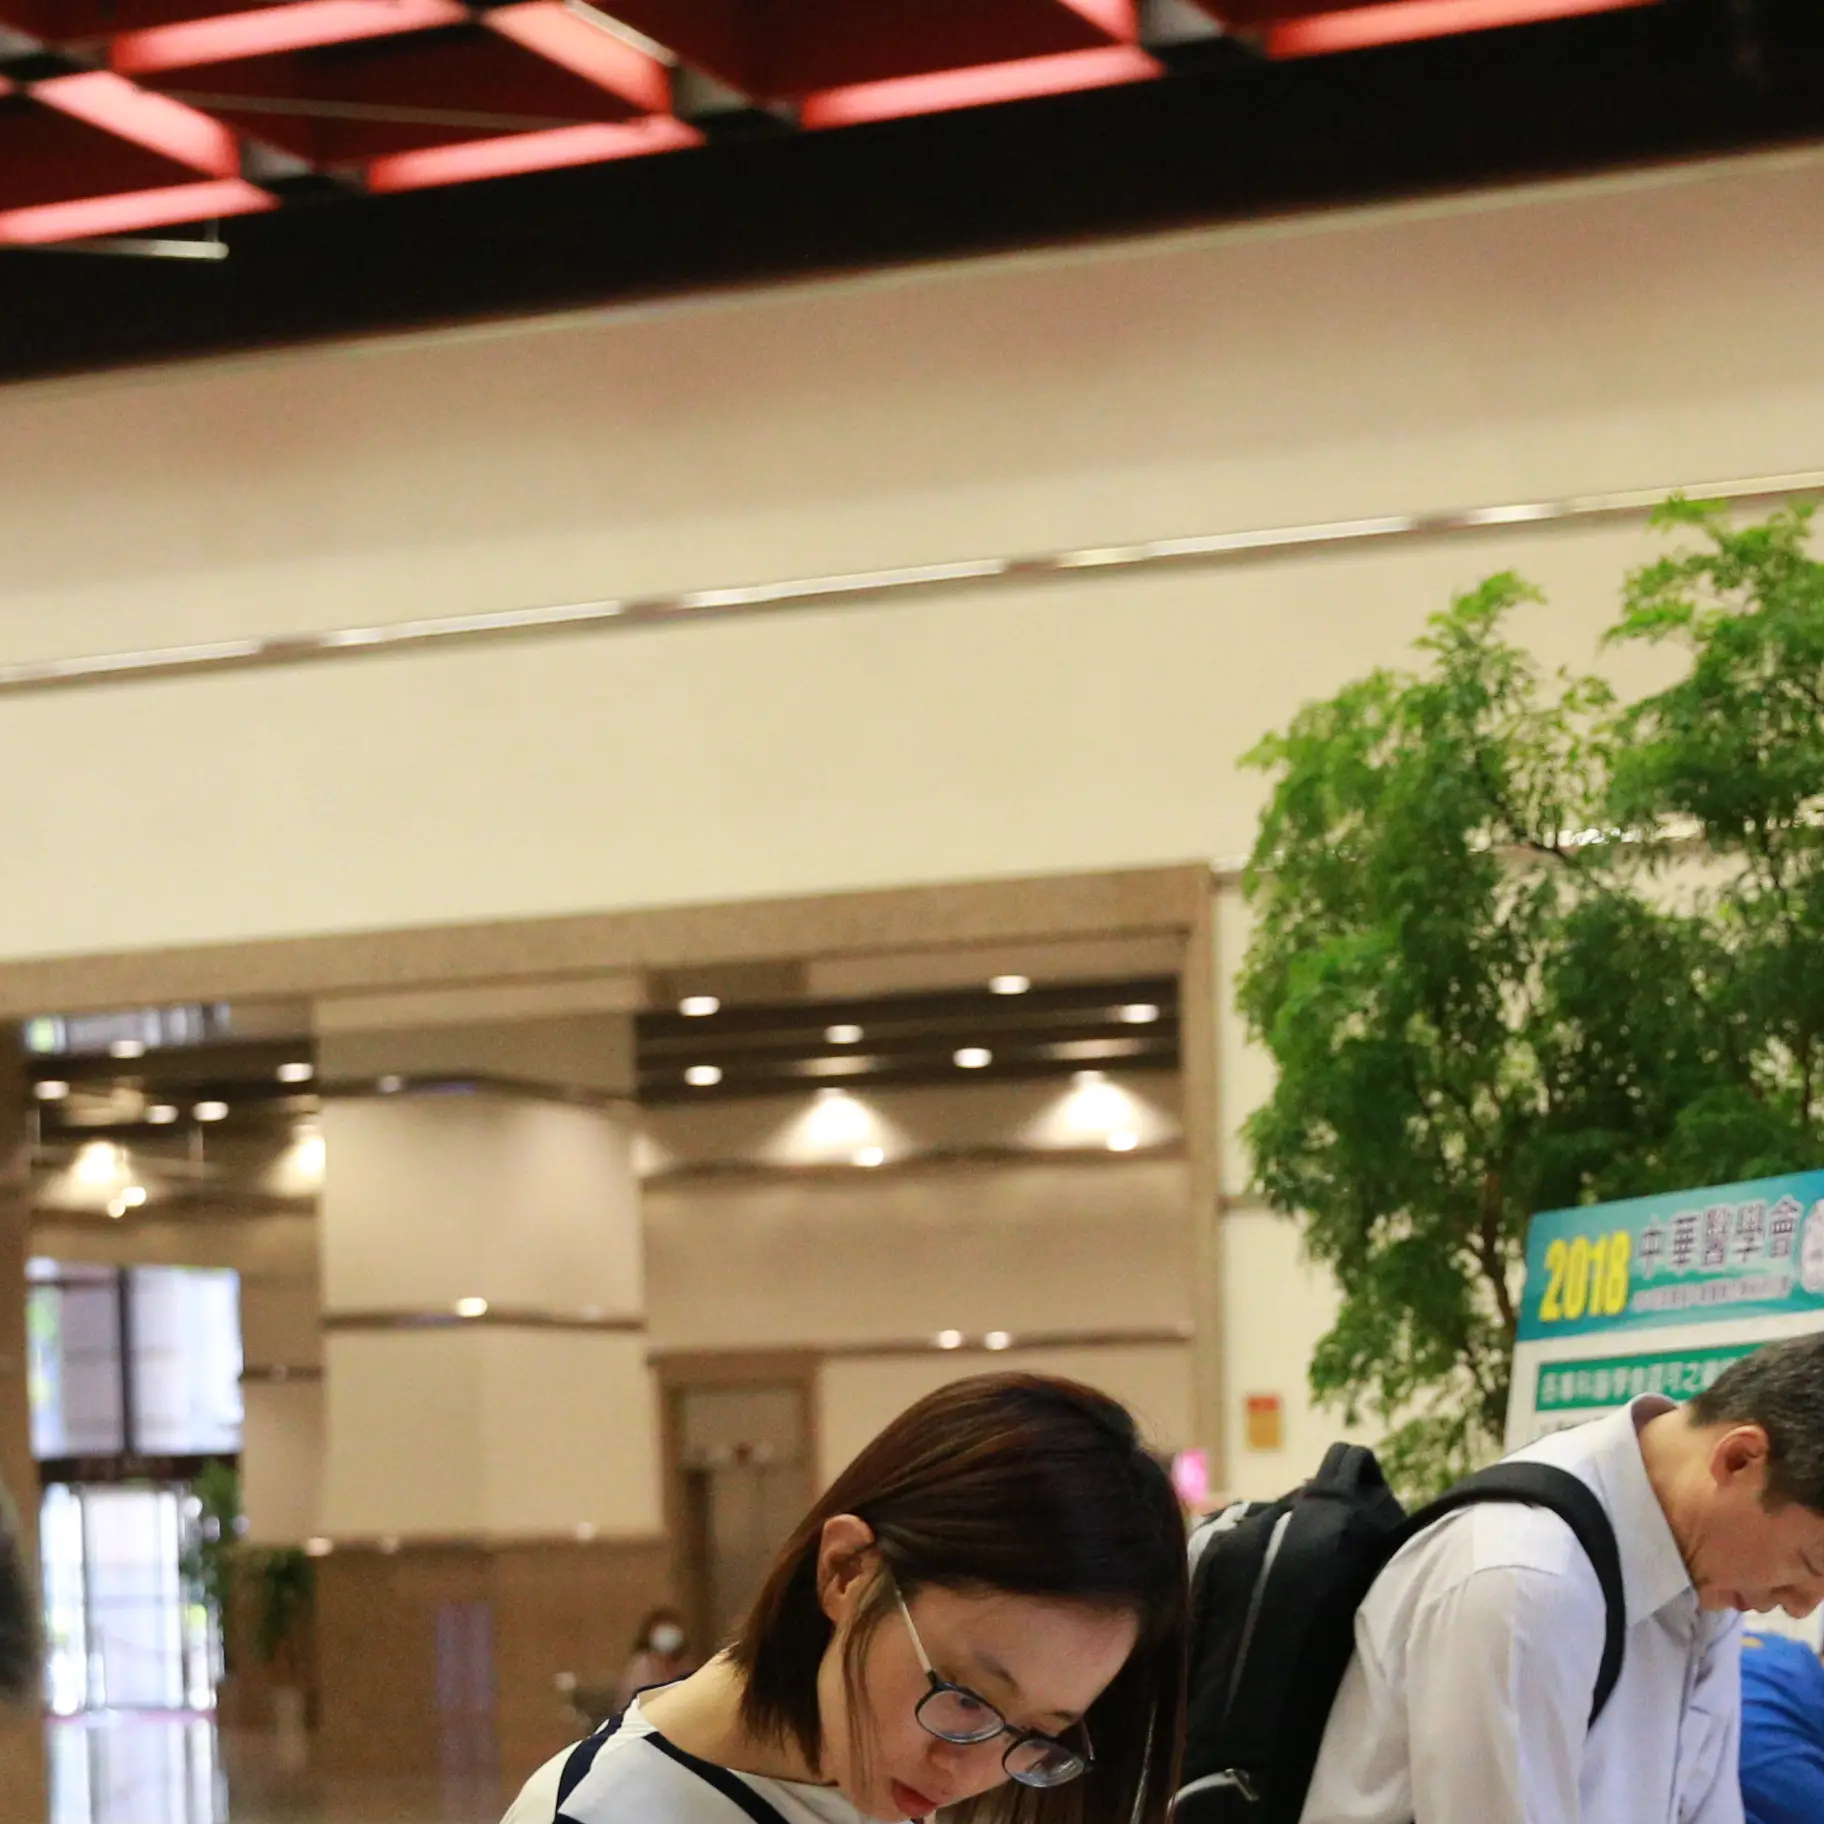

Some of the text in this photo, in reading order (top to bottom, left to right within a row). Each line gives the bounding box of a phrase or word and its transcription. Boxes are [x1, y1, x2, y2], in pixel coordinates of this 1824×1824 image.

[1541, 1231, 1631, 1321] 2018
[1640, 1197, 1799, 1274] 中華醫學會
